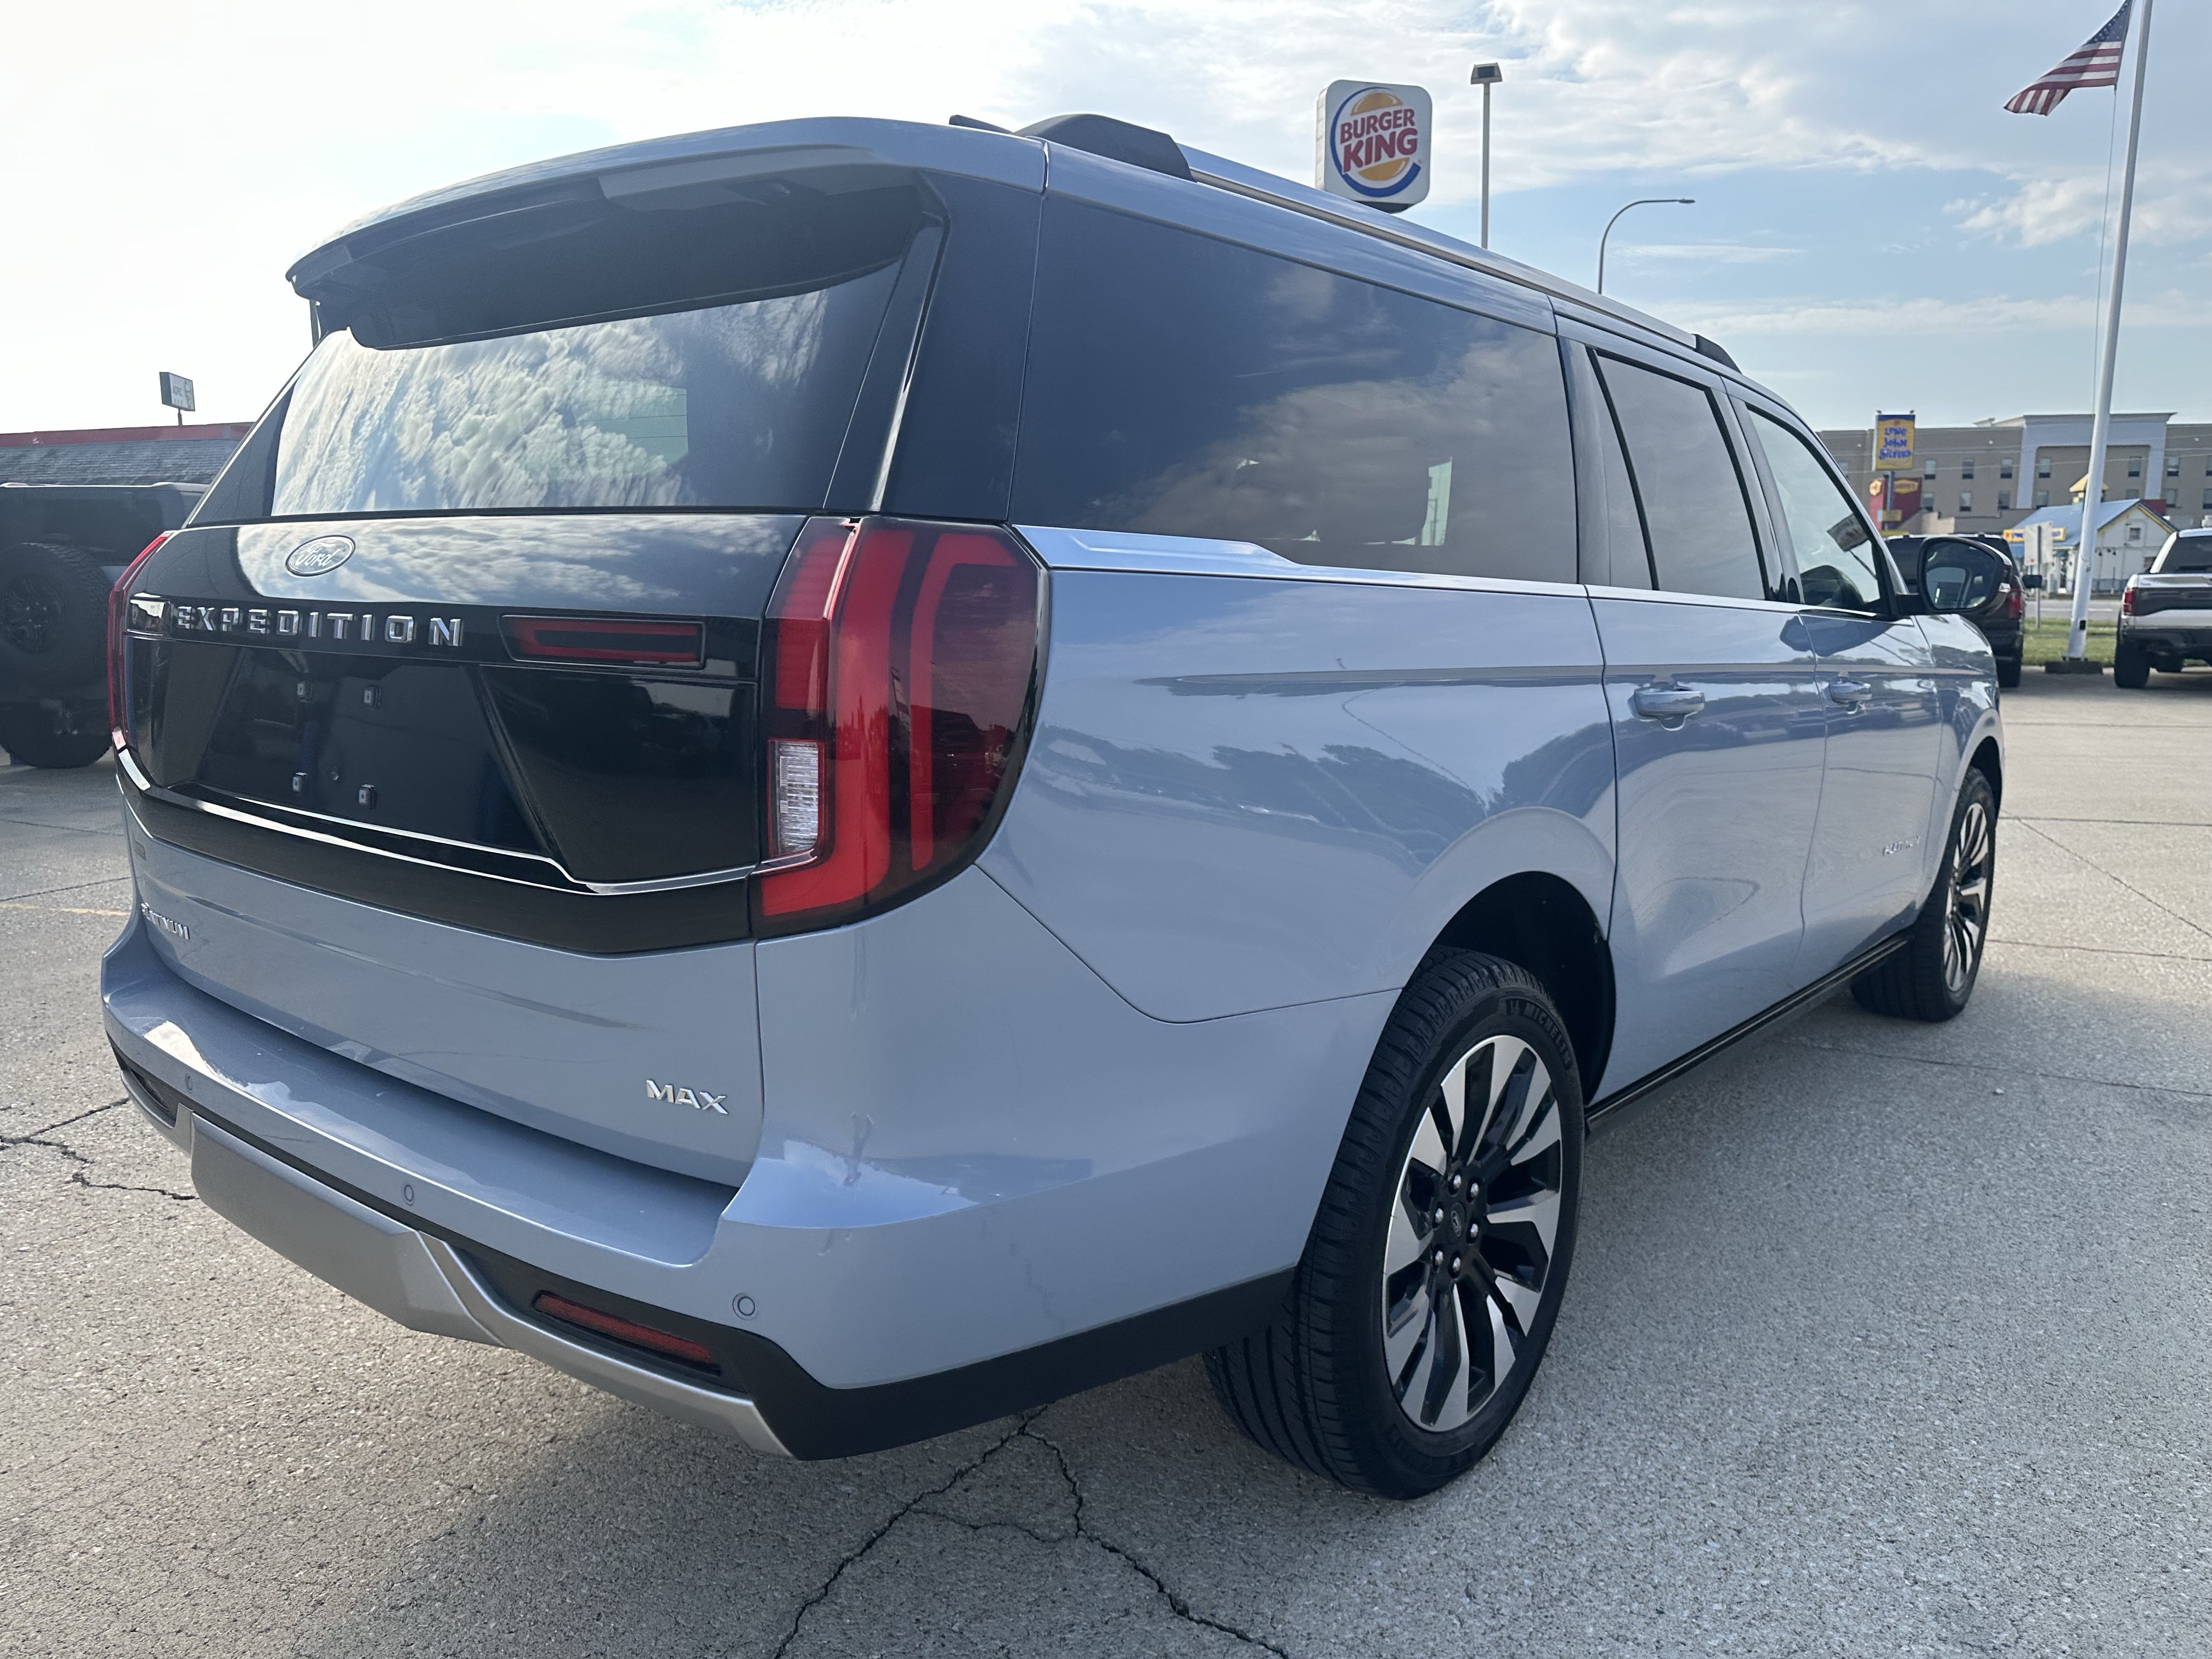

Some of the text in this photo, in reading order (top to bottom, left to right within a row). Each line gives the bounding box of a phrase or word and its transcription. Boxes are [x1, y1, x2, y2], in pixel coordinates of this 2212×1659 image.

[1340, 109, 1415, 144] BURGER
[1344, 128, 1418, 173] KING
[173, 385, 183, 397] KFC
[295, 542, 341, 567] Ford
[177, 606, 462, 647] EXPEDITION
[646, 1079, 728, 1114] MAX
